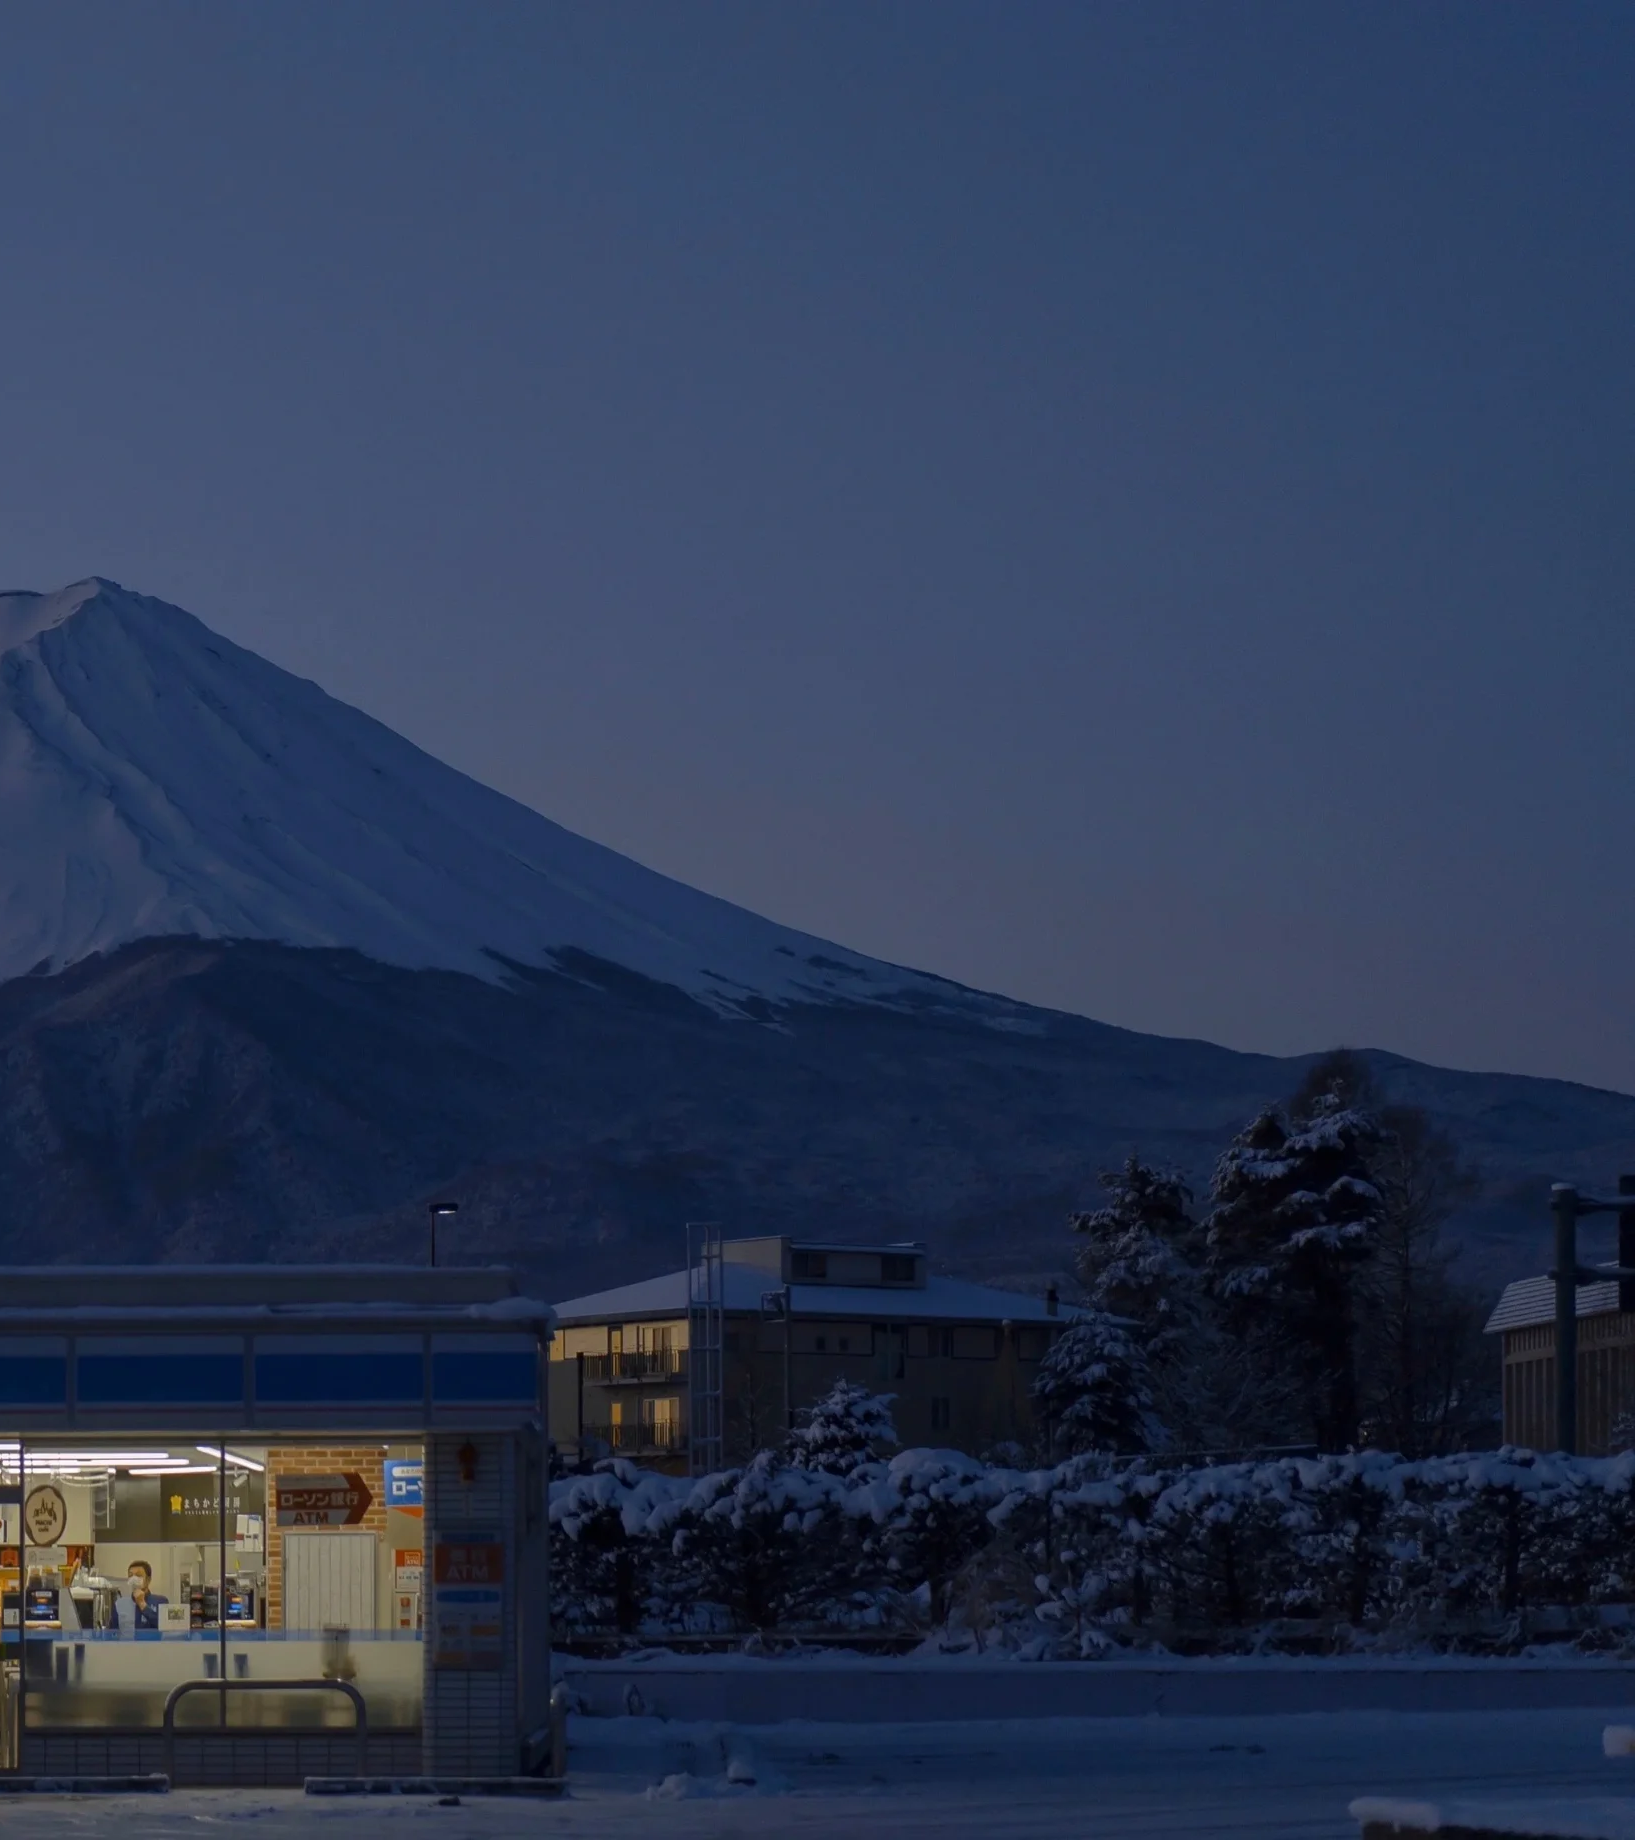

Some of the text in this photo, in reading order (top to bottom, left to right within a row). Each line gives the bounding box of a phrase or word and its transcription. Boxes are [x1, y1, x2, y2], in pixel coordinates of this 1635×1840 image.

[280, 1491, 360, 1506] ローソン銀行
[293, 1511, 329, 1525] ATM
[446, 1564, 489, 1581] ATM
